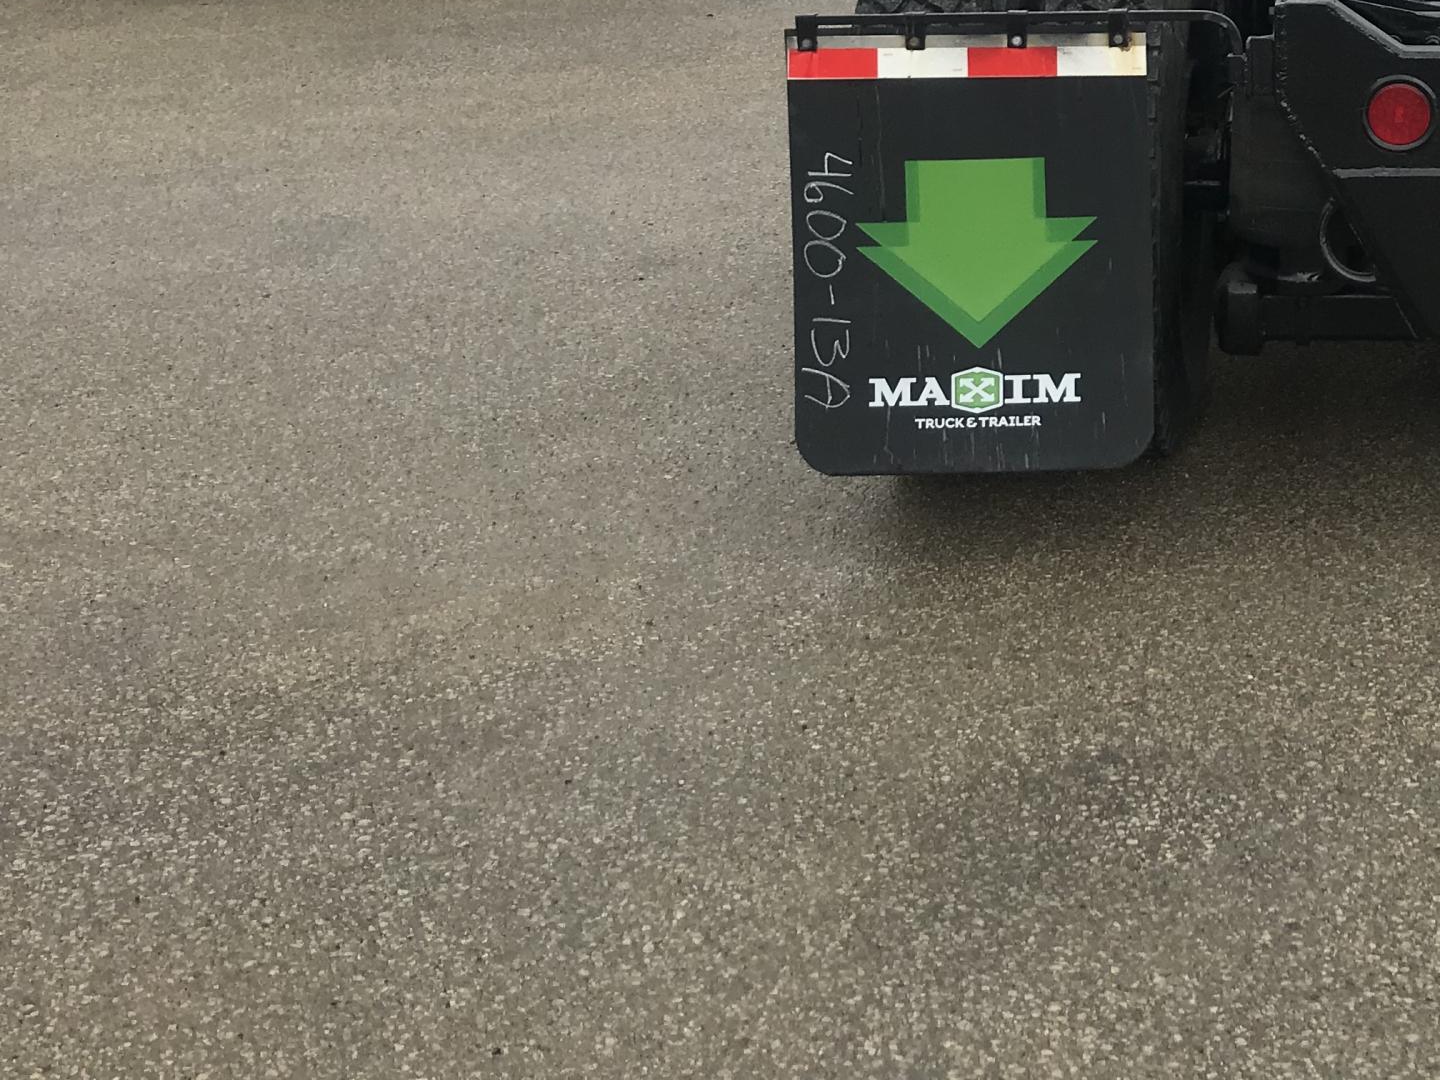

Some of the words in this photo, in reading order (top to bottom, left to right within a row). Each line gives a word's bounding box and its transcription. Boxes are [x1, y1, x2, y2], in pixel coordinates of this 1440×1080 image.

[802, 152, 854, 410] 4600-13A
[868, 369, 1082, 411] MAXIM
[914, 417, 966, 430] TRUCK
[978, 415, 1042, 428] TRAILER
